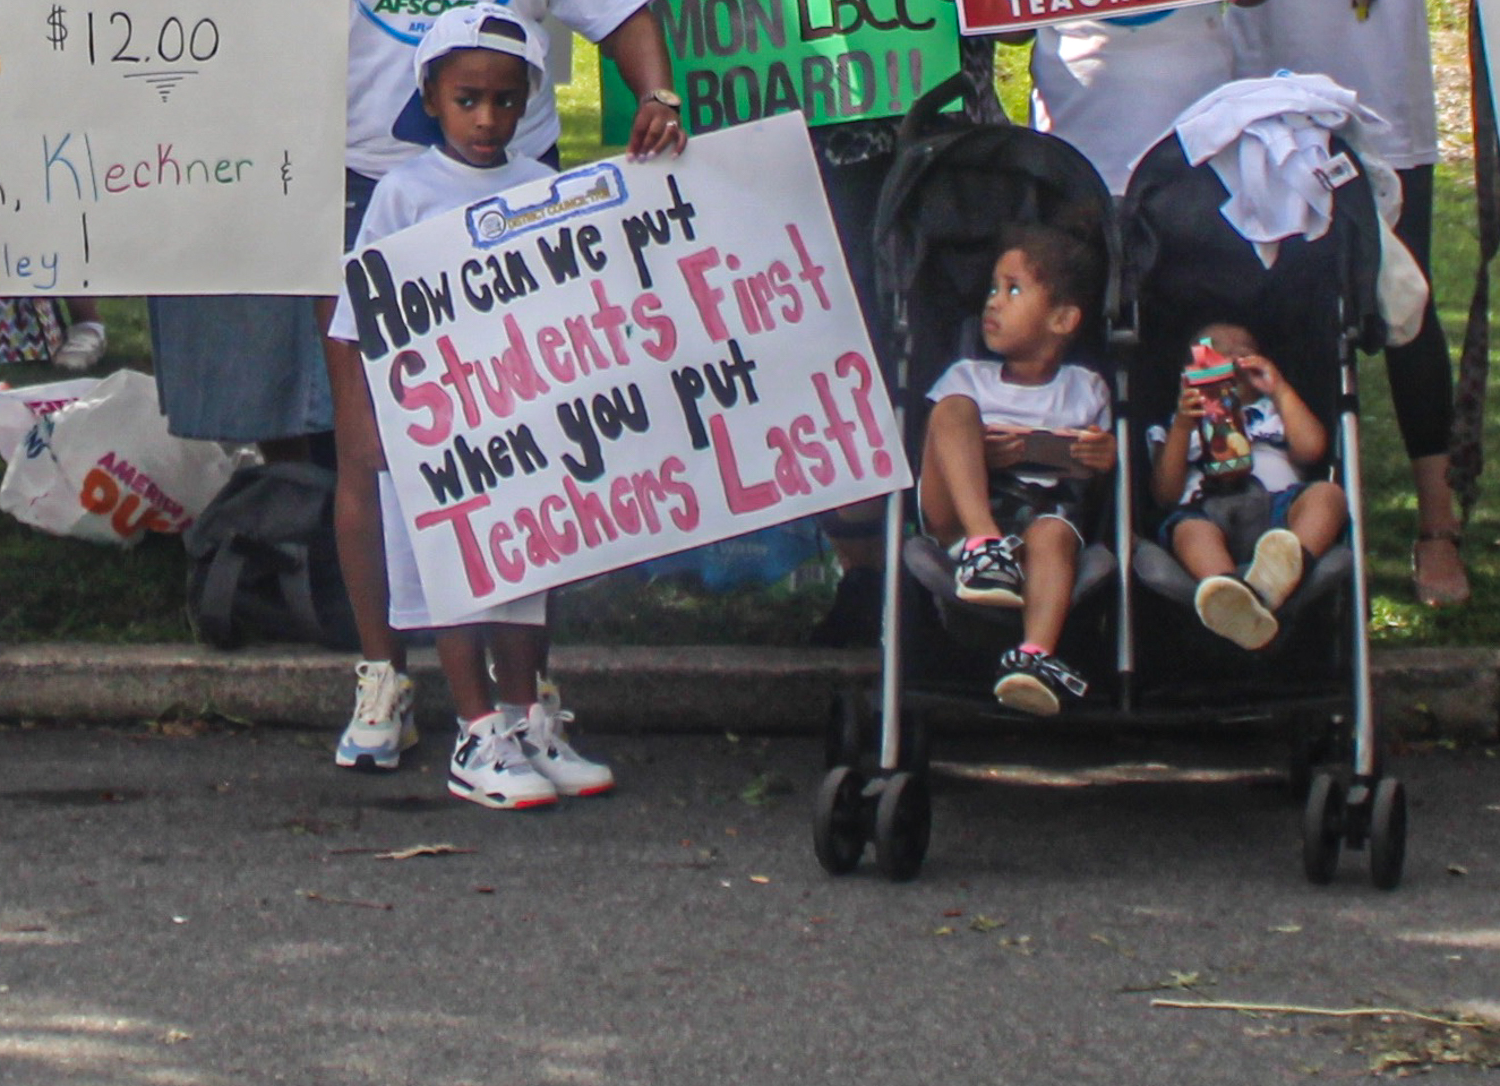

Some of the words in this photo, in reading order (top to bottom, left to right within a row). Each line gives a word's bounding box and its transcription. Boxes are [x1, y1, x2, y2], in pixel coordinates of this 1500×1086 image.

[345, 248, 455, 360] How
[462, 245, 539, 315] can
[623, 172, 697, 287] put
[389, 282, 680, 448] Students
[680, 225, 834, 348] First
[414, 454, 702, 600] Teachers
[705, 350, 895, 516] Last?
[419, 419, 549, 504] when
[556, 380, 650, 483] you
[670, 339, 762, 450] put
